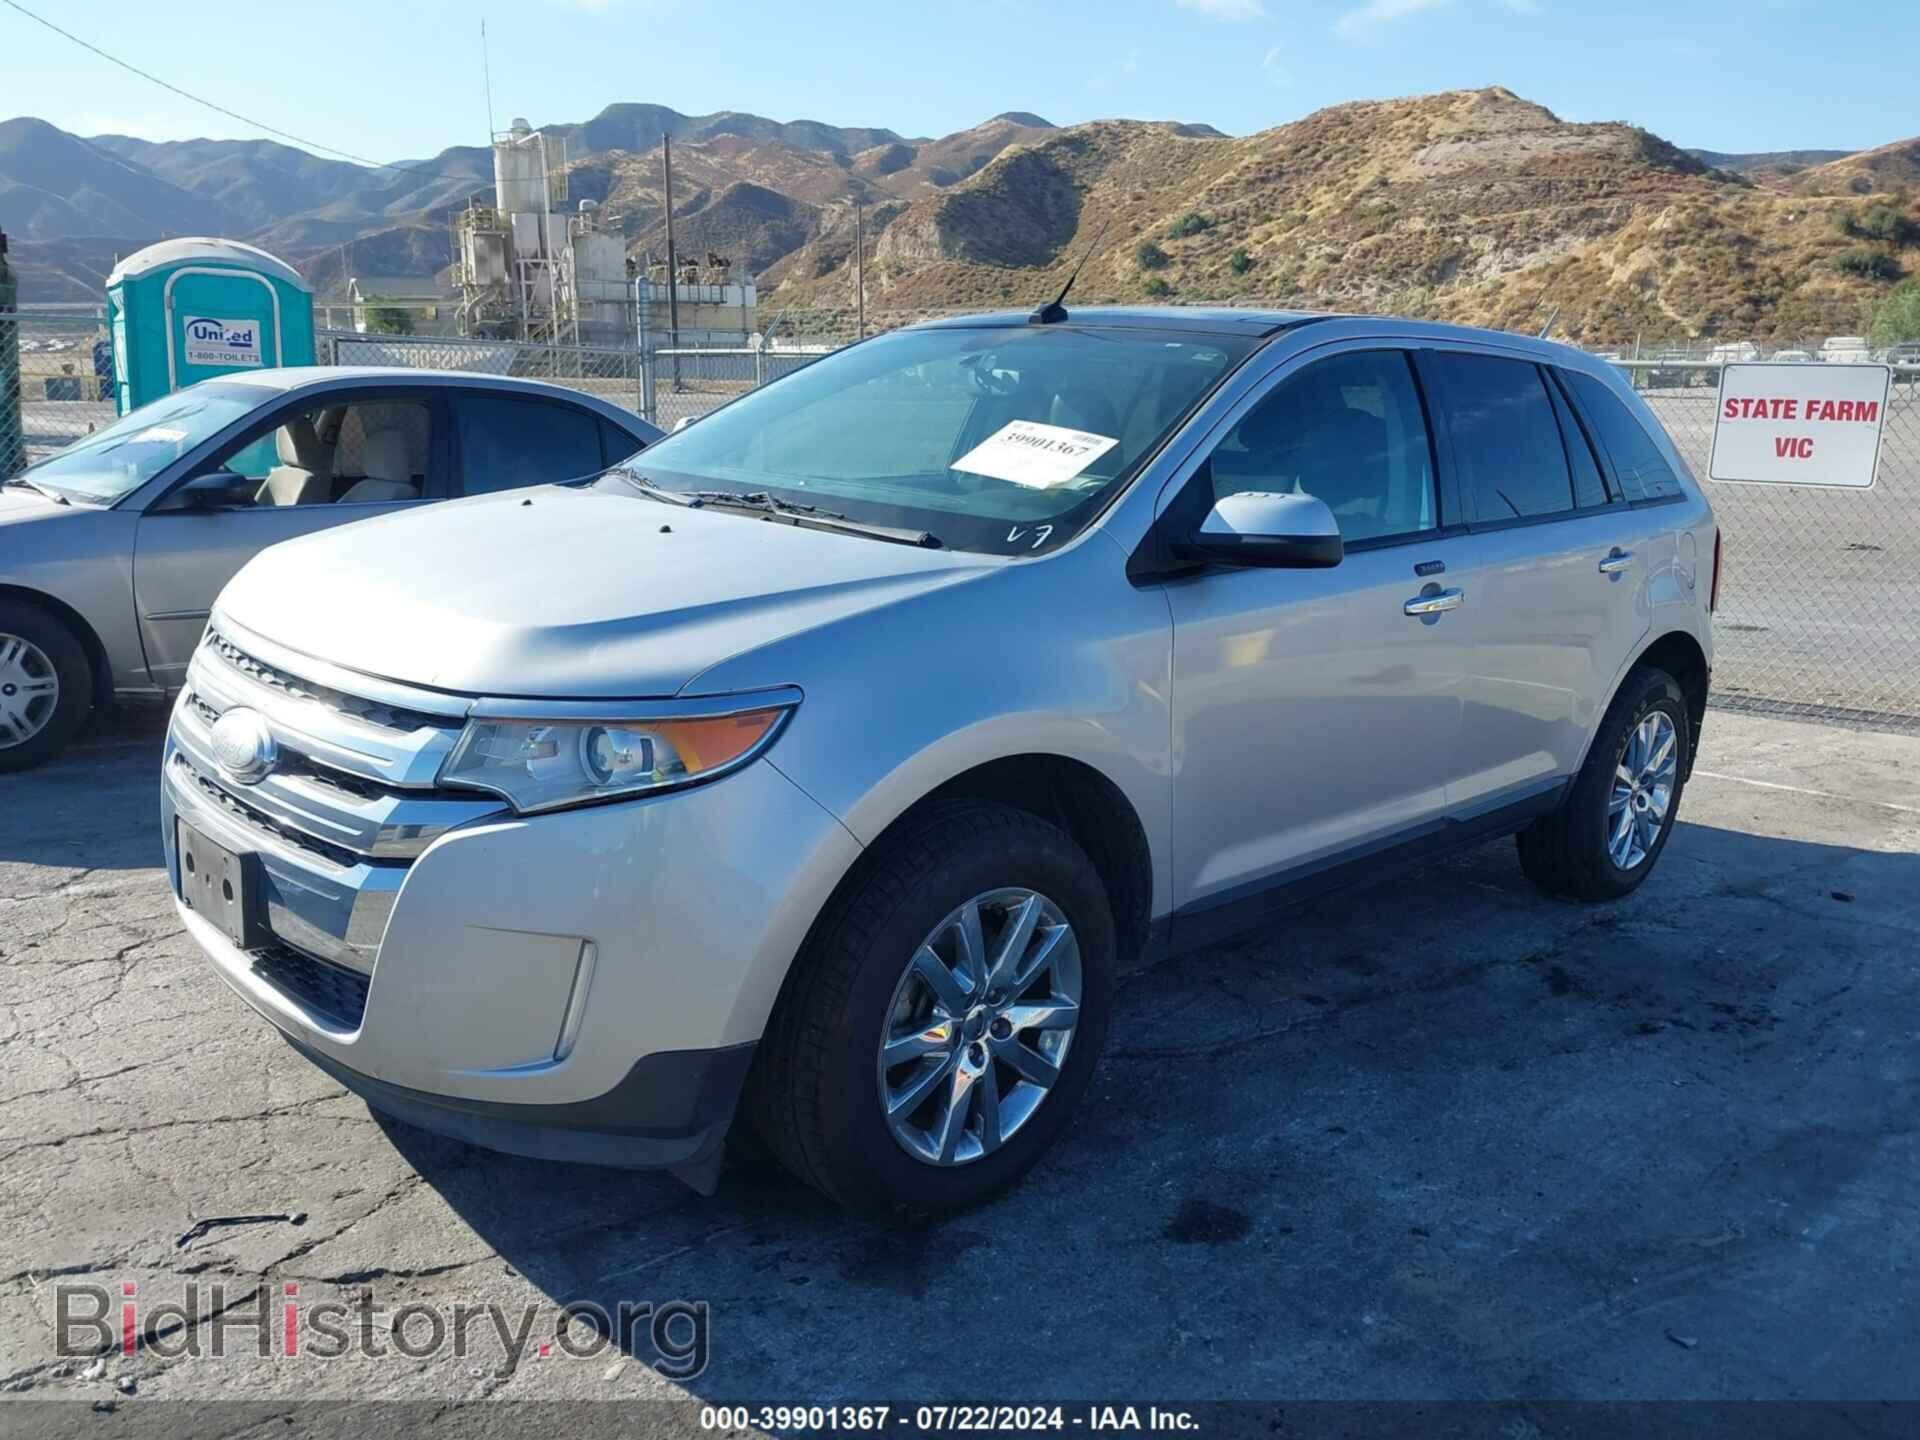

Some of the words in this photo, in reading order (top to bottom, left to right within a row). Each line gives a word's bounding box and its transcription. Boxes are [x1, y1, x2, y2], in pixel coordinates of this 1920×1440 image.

[187, 351, 260, 363] 1-800-TOILETS
[1724, 397, 1797, 420] STATE
[1805, 399, 1879, 423] FARM
[1774, 437, 1814, 459] VIC
